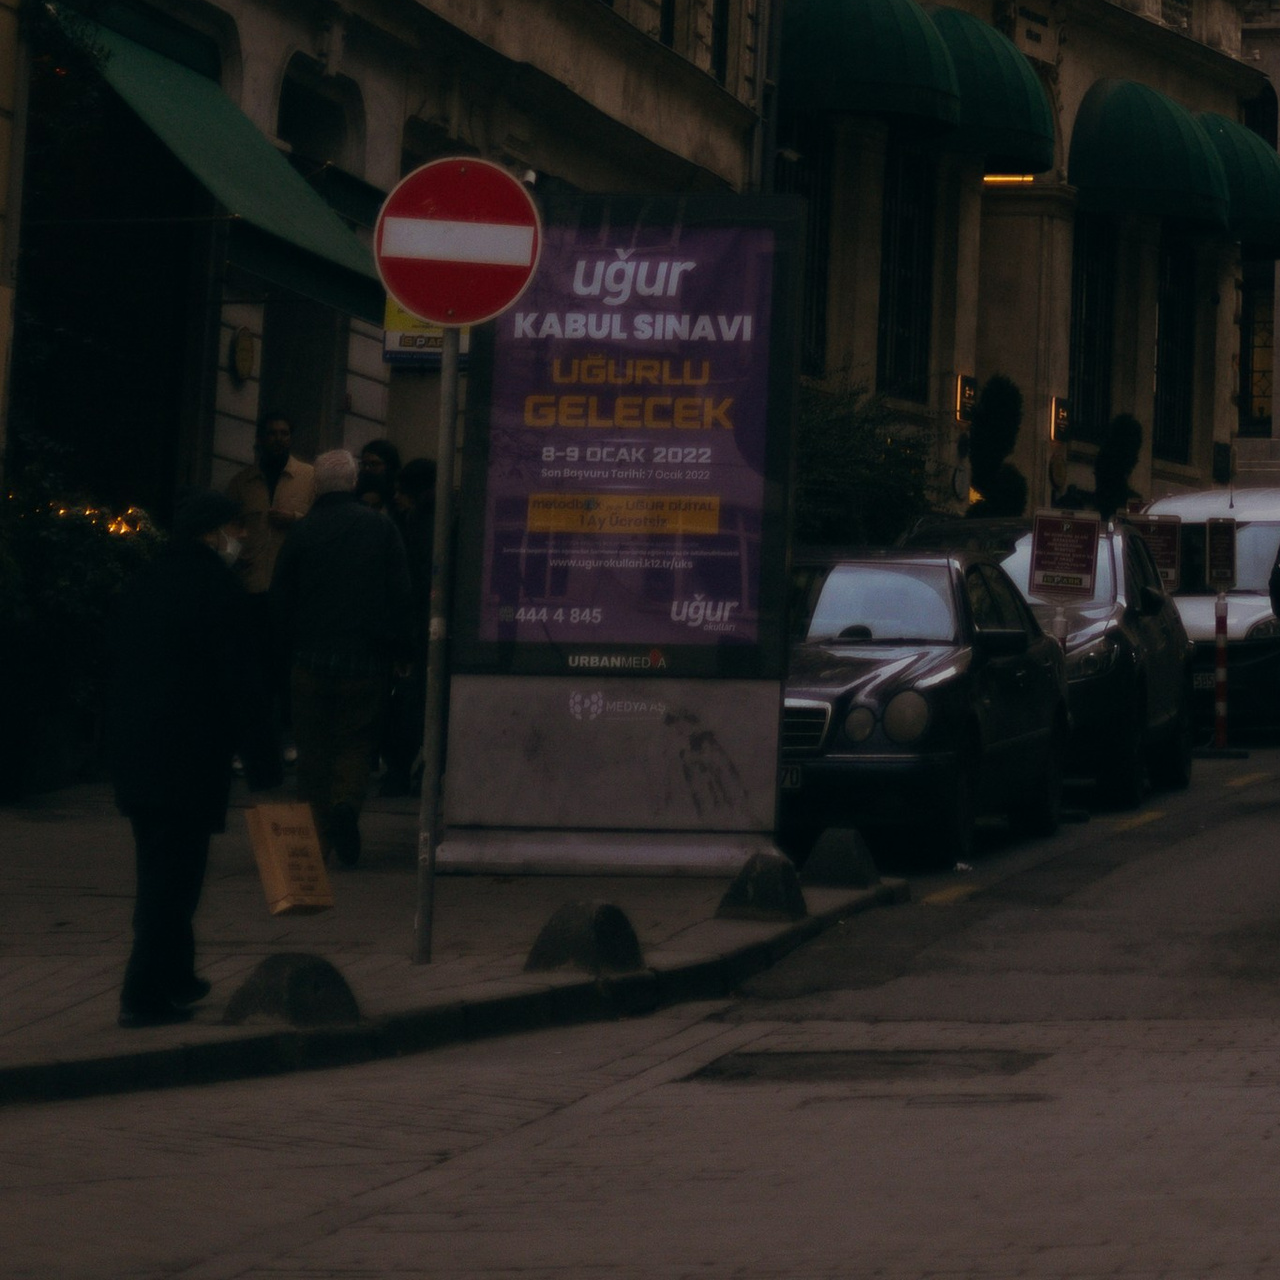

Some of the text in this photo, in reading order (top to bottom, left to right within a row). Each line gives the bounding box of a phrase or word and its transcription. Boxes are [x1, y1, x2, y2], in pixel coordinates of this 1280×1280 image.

[572, 248, 697, 306] uğur
[514, 312, 752, 341] KABUL SINAVI
[552, 352, 711, 386] UĞURLU
[524, 395, 735, 430] GELECEK
[541, 446, 712, 464] 8-9 OCAK 2022
[541, 468, 561, 479] Son
[563, 468, 609, 481] Başvuru
[647, 470, 654, 480] 7
[655, 469, 683, 480] Ocak
[685, 470, 711, 480] 2022
[515, 607, 602, 624] 444 4 845
[670, 593, 739, 627] uğur
[606, 701, 647, 712] MEDYA
